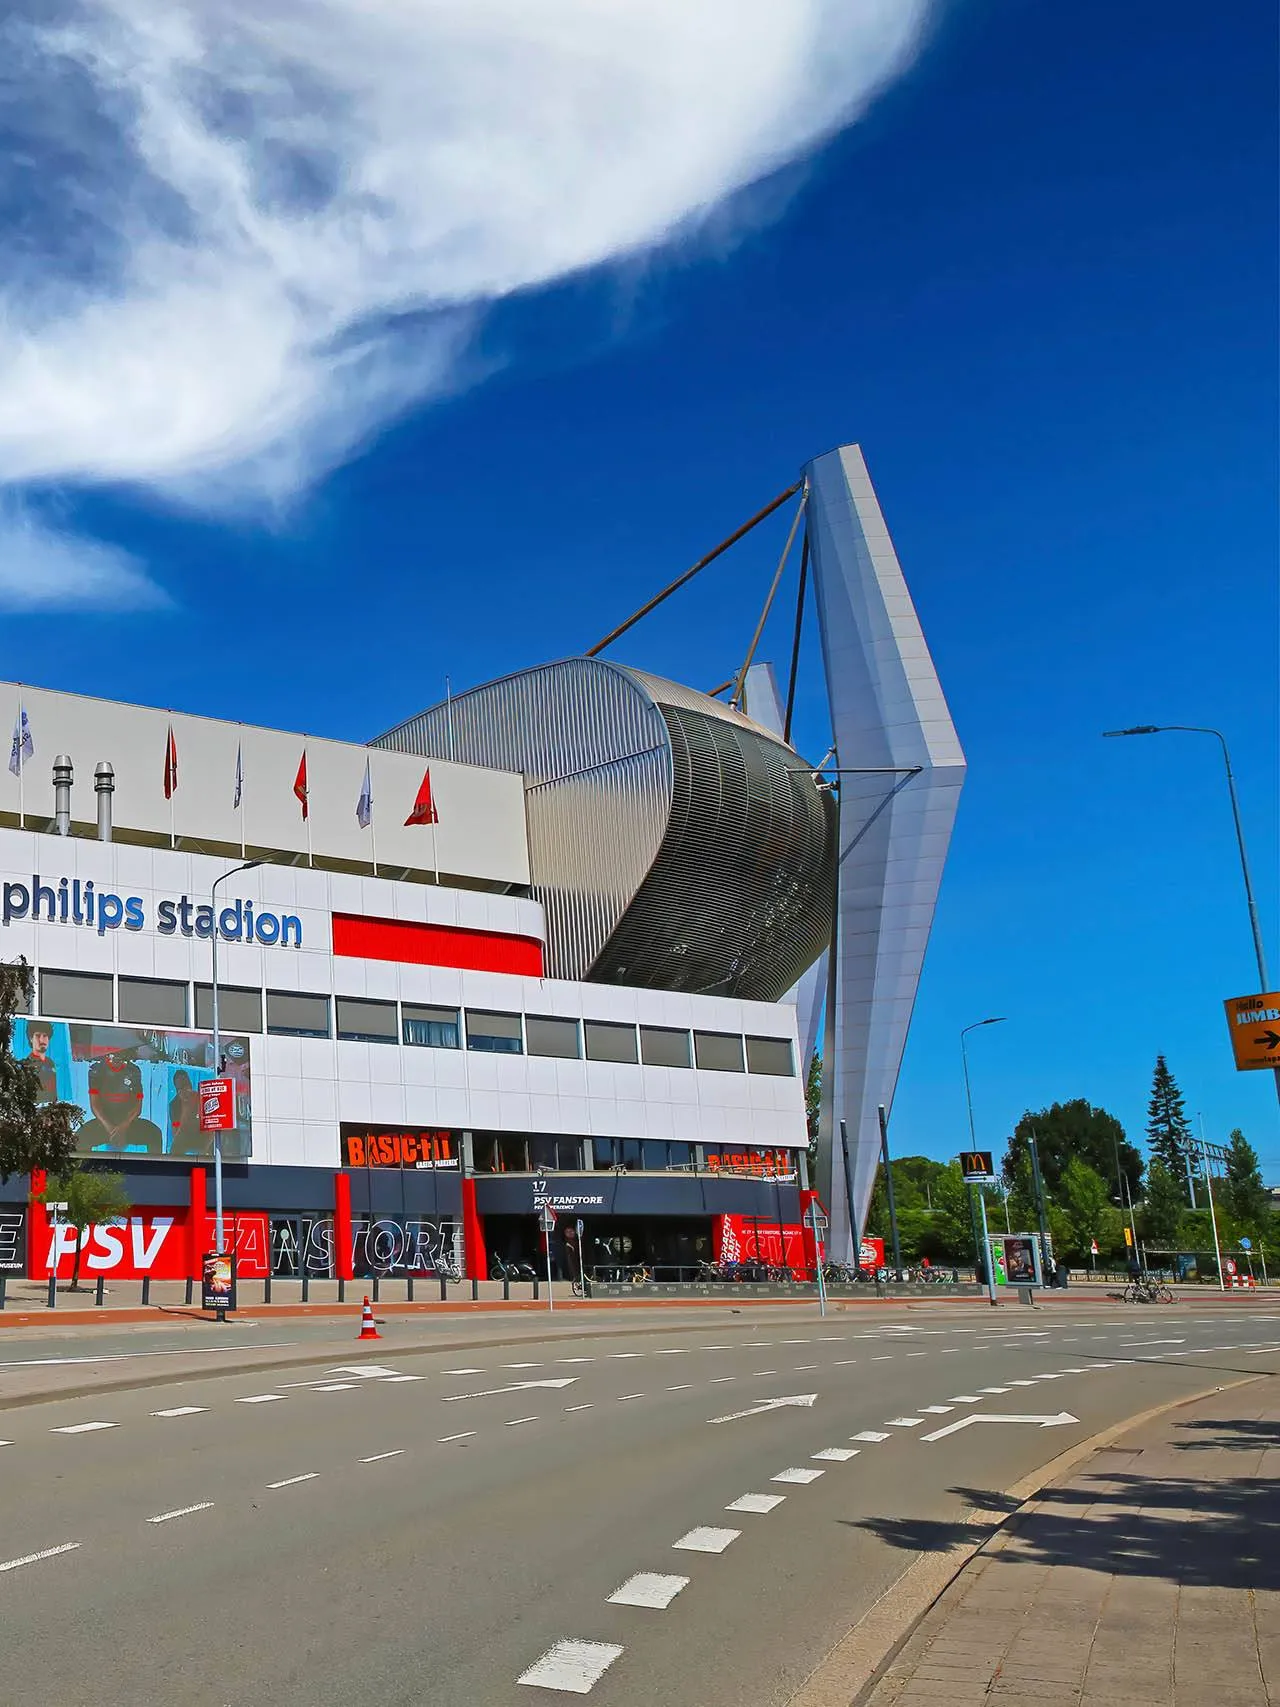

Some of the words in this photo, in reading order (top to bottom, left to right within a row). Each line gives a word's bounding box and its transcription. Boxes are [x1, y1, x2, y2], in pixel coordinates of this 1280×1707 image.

[2, 875, 145, 937] philips
[157, 896, 303, 949] stadion
[1237, 1008, 1280, 1025] JUMB
[532, 1181, 547, 1193] 17
[533, 1197, 552, 1205] PSV
[553, 1197, 604, 1205] FANSTORE
[45, 1216, 175, 1269] PSV
